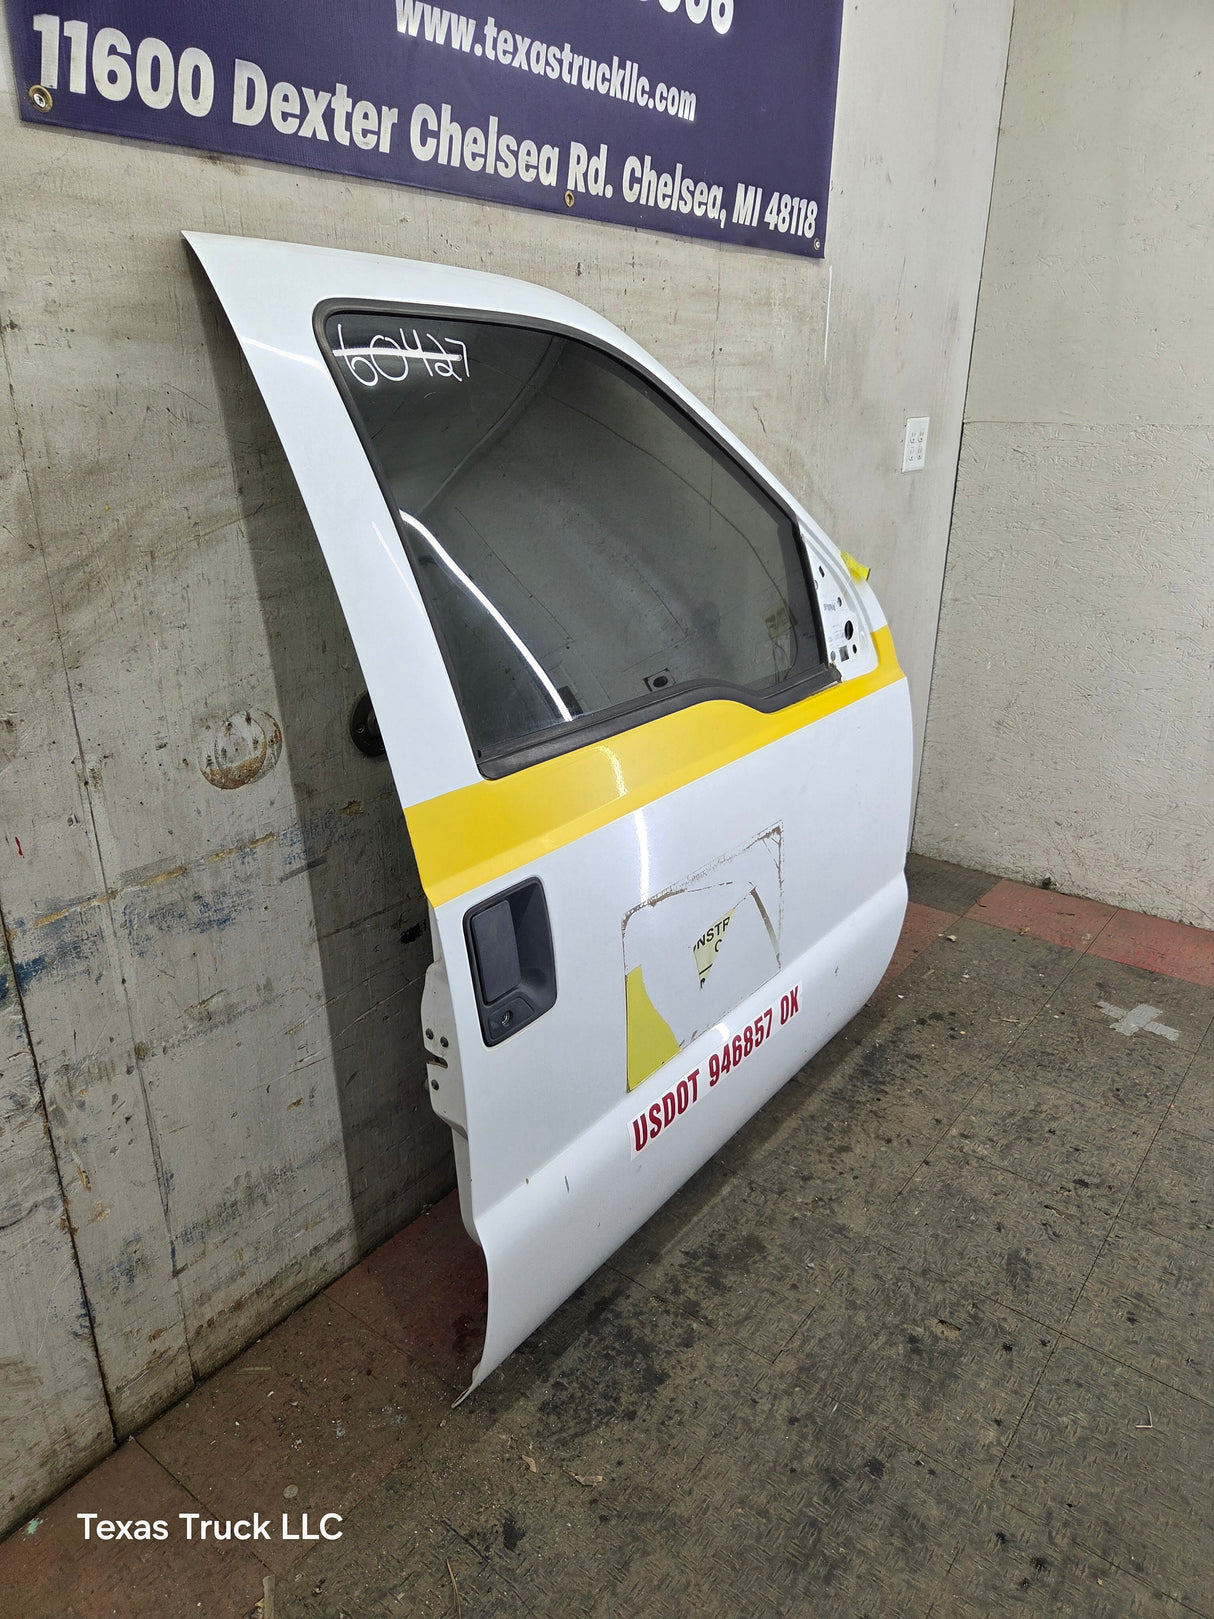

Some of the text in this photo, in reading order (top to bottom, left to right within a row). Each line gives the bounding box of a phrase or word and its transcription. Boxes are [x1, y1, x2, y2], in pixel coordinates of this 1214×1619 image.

[33, 13, 818, 239] 11600 Dexter Chelsea Rd. Chelsea, MI 48118
[395, 0, 697, 122] www.texastruckllc.com
[337, 323, 470, 387] 60427
[632, 985, 800, 1152] USDOT 946857 OK
